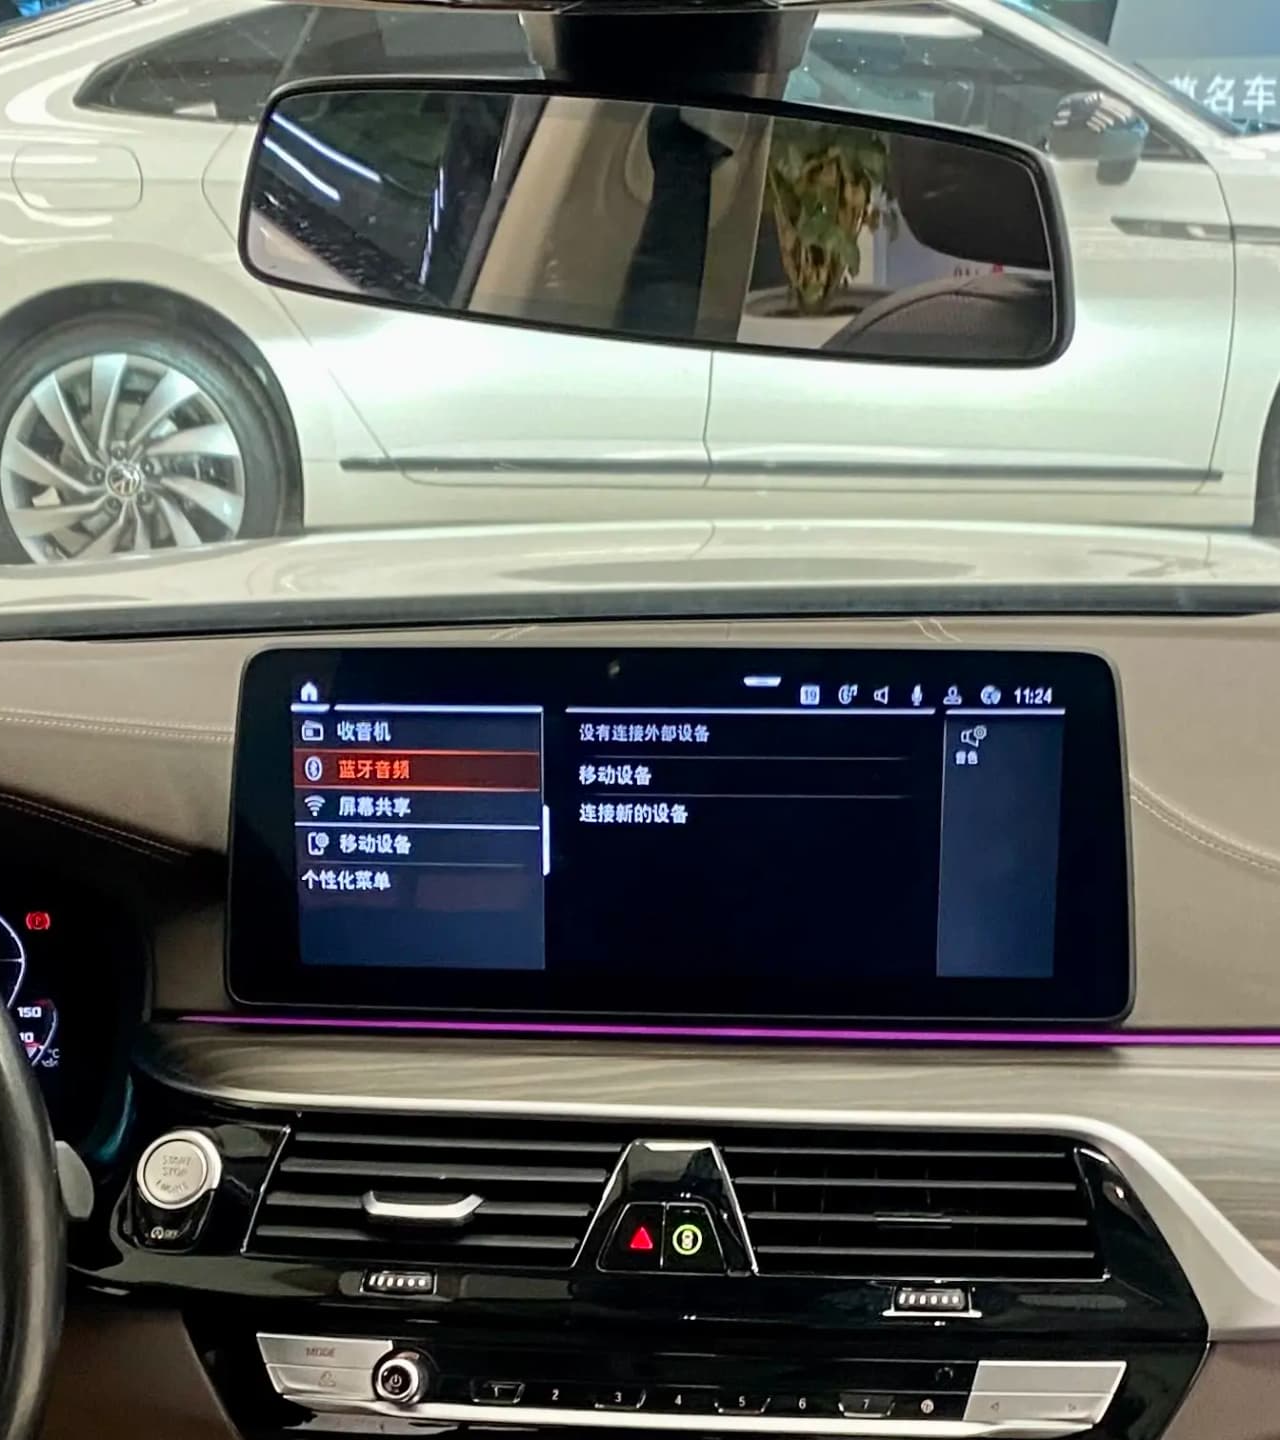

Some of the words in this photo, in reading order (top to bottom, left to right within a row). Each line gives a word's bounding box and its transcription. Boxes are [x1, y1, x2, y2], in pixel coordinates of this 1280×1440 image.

[1014, 686, 1053, 705] 11:24
[337, 721, 391, 742] 收音机
[579, 723, 710, 742] 没有连接外部设备
[338, 760, 410, 779] 蓝牙音频
[578, 764, 652, 786] 移动设备
[338, 796, 411, 817] 屏幕共享
[579, 802, 689, 824] 连接新的设备
[339, 833, 411, 855] 移动设备
[301, 869, 391, 891] 个性化菜单
[17, 1006, 42, 1018] 150
[552, 1388, 559, 1400] 2
[615, 1391, 622, 1404] 3
[738, 1395, 746, 1408] 5
[798, 1397, 806, 1410] 6
